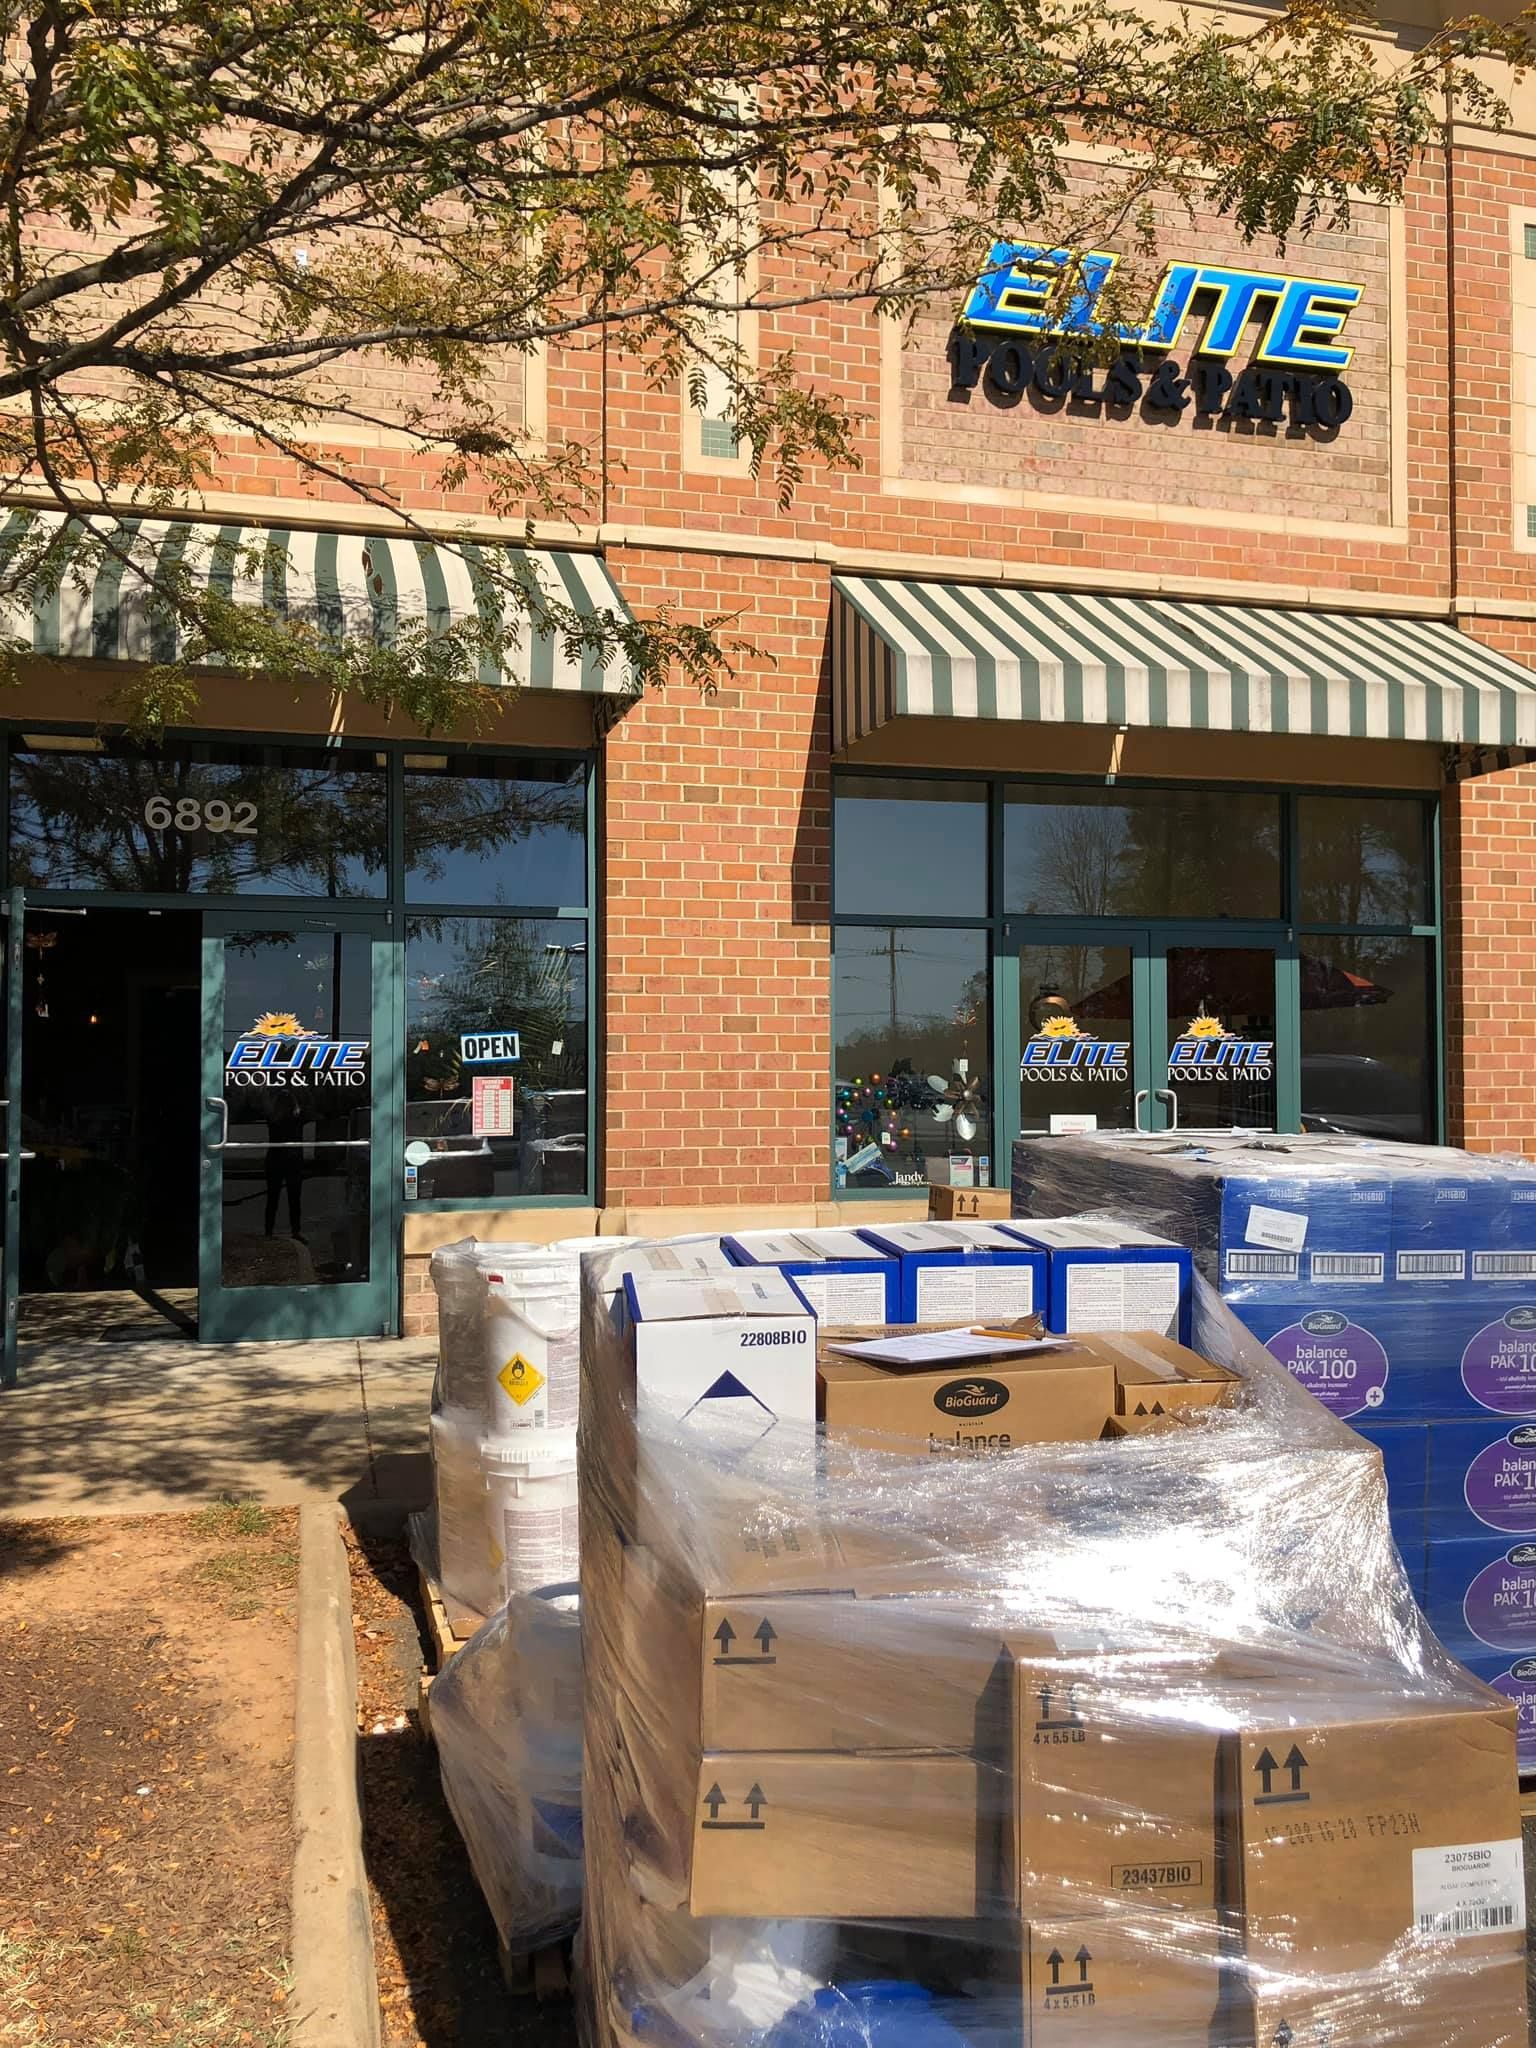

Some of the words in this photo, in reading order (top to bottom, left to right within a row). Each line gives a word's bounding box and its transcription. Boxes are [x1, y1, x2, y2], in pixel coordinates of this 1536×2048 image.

[958, 238, 1366, 371] ELITE
[144, 796, 259, 836] 6892
[225, 1041, 370, 1069] ELITE
[464, 1035, 516, 1060] OPEN
[1020, 1041, 1130, 1067] ELITE
[1168, 1041, 1274, 1067] ELITE
[225, 1071, 287, 1086] POOLS
[290, 1071, 309, 1086] &
[314, 1071, 366, 1086] PATIO
[1020, 1067, 1067, 1081] POOLS
[1070, 1068, 1085, 1082] &
[1089, 1067, 1128, 1082] PATIO
[1168, 1067, 1214, 1081] POOLS
[1215, 1068, 1228, 1081] &
[1232, 1067, 1272, 1081] PATIO
[895, 1171, 925, 1185] Jandy
[740, 1330, 807, 1347] 22808BIO
[1296, 1344, 1348, 1359] balance
[1319, 1359, 1357, 1379] 100
[945, 1393, 998, 1408] BioGuard
[1033, 1732, 1041, 1745] 4
[1052, 1731, 1069, 1744] 5.5
[1071, 1730, 1086, 1743] LB
[1444, 1850, 1492, 1864] 23075BIO
[1122, 1866, 1192, 1885] 23437BIO
[1044, 1997, 1051, 2010] 4
